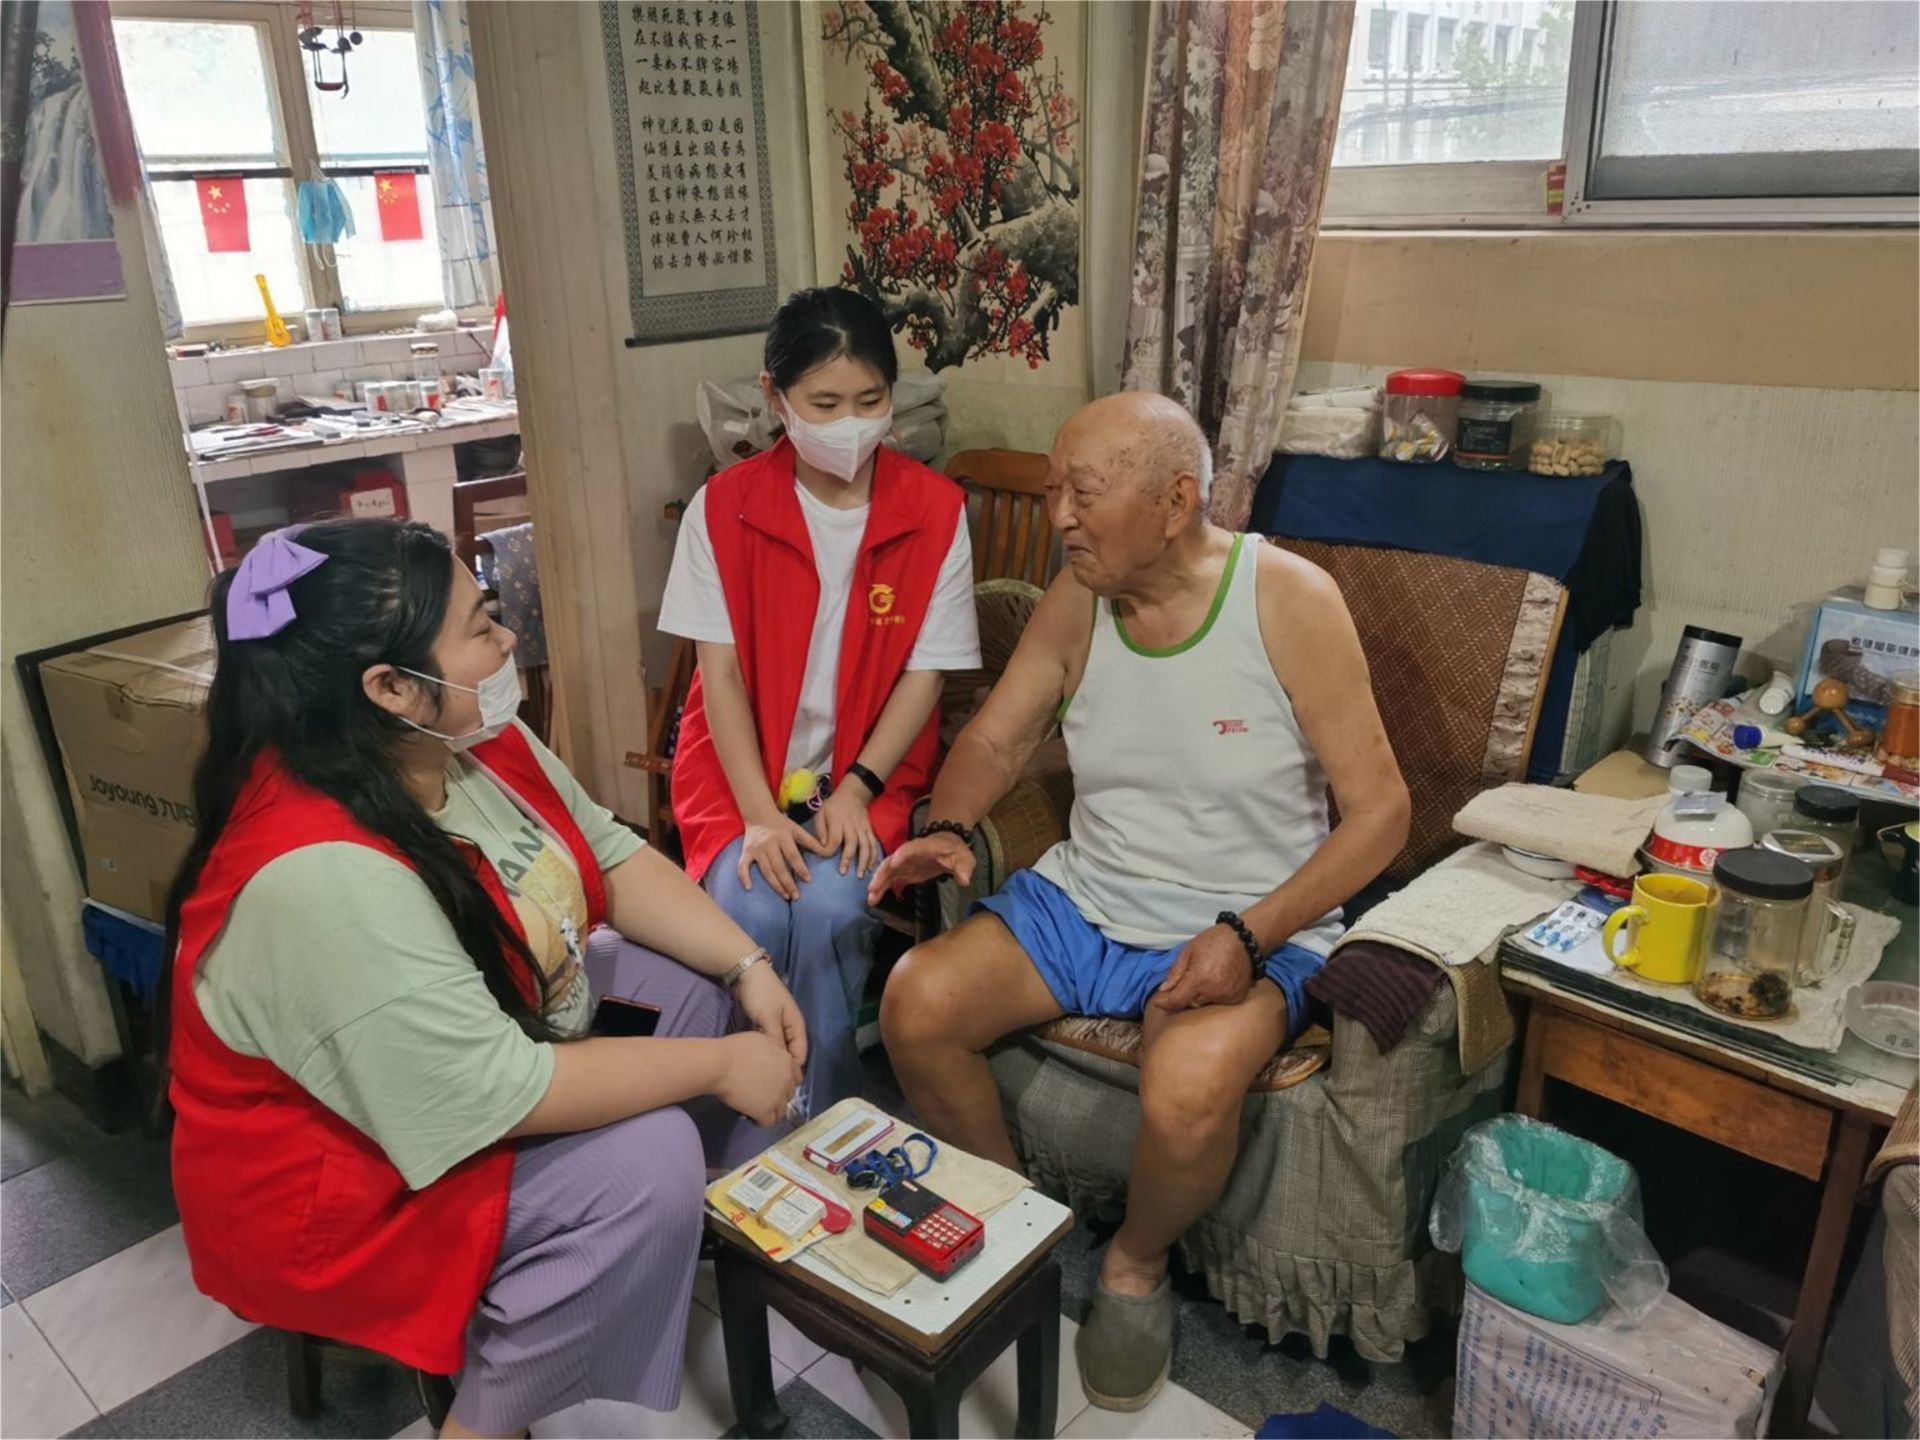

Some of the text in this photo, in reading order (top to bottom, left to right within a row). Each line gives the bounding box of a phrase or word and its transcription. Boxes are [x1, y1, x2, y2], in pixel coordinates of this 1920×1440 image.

[707, 1, 725, 98] 老不容易
[722, 1, 743, 98] 像一場戲
[89, 772, 159, 816] Joyoung
